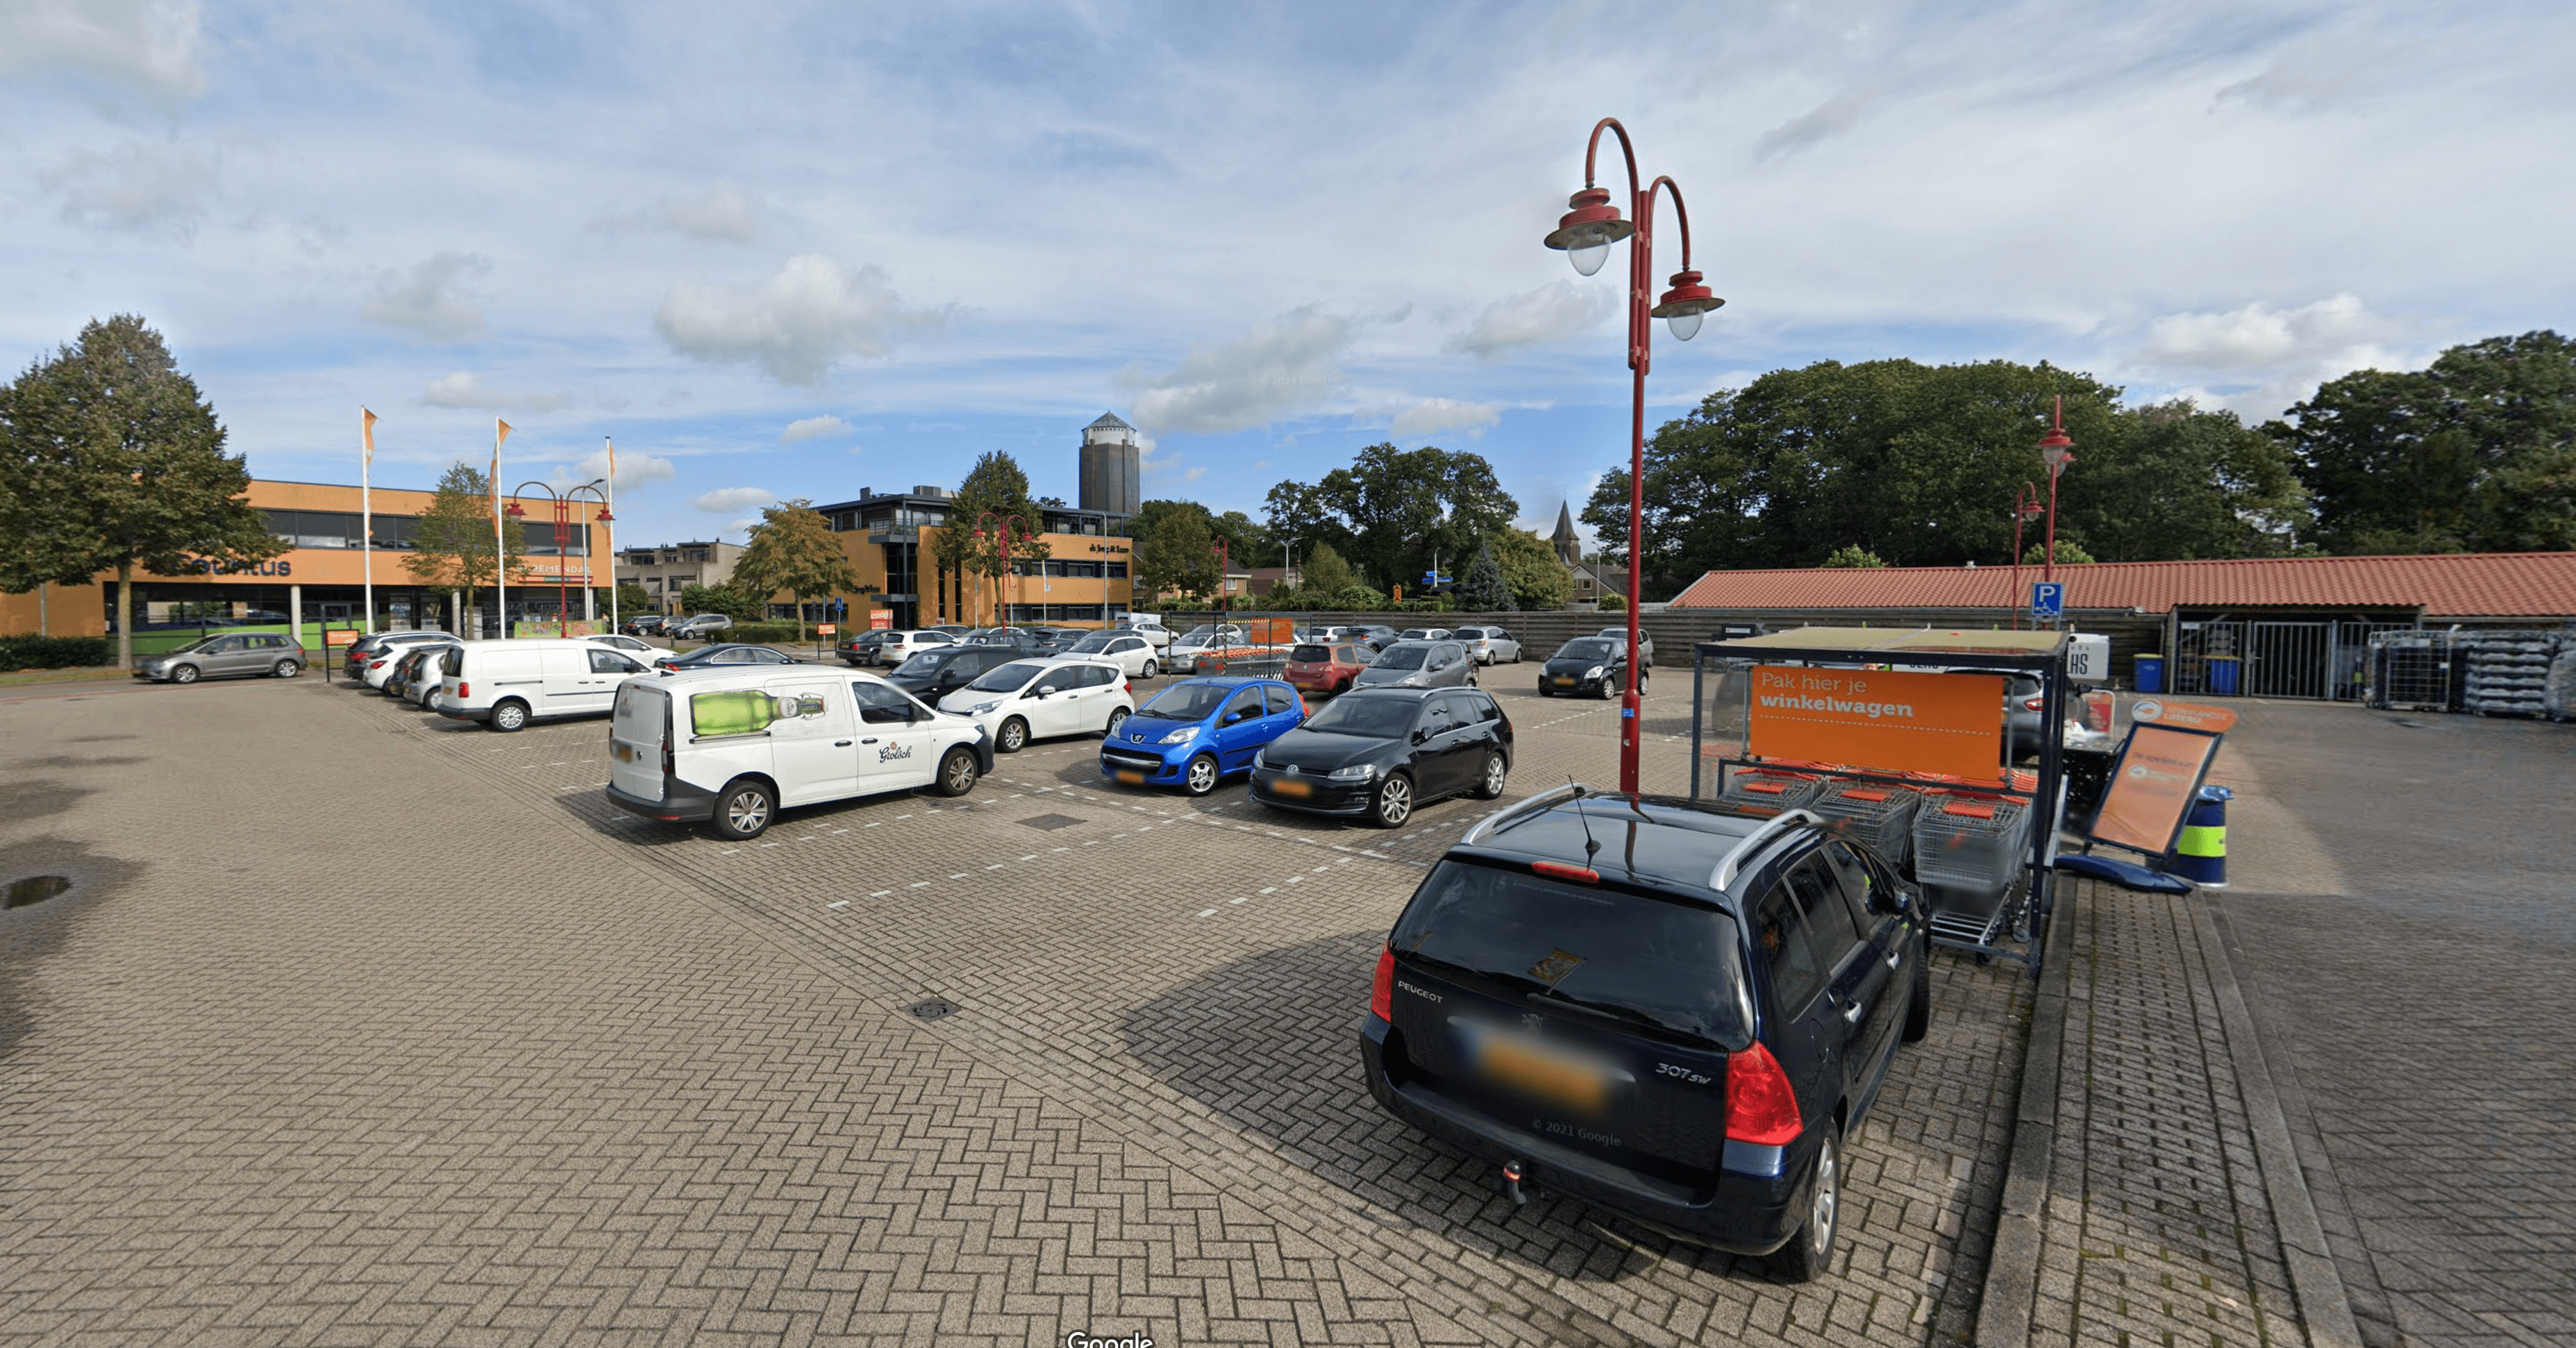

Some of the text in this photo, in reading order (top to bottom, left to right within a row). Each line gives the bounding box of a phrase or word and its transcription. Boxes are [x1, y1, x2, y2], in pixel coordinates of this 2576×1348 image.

[2039, 586, 2055, 602] P
[1762, 672, 1866, 695] Pak hier je
[1759, 693, 1914, 718] winkelwagen
[879, 745, 912, 764] Grolsch
[1398, 980, 1444, 1004] PEUGEOT
